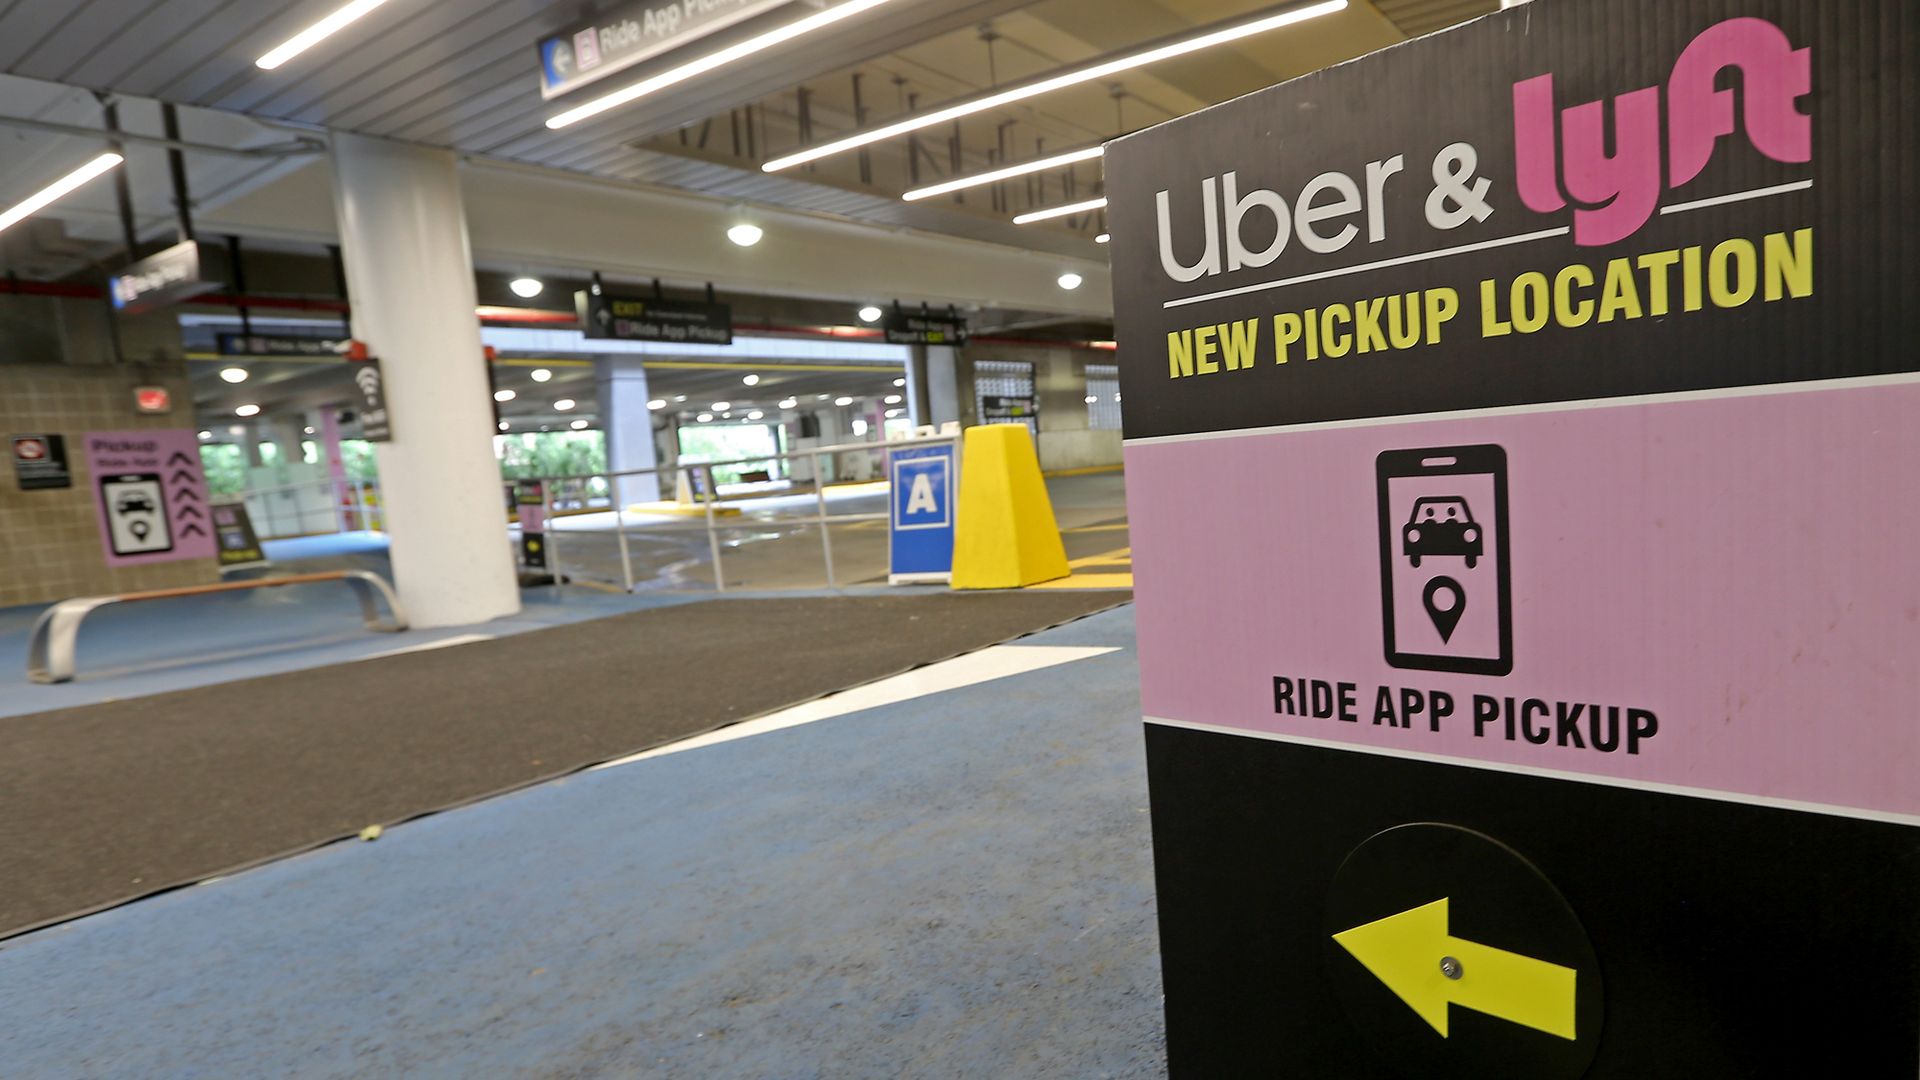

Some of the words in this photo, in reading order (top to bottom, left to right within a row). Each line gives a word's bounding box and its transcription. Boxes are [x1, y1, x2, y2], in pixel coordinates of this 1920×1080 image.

[600, 19, 641, 53] Ride
[642, 3, 681, 36] App
[1156, 154, 1404, 283] Uber
[1424, 142, 1495, 230] &
[1513, 17, 1812, 247] lyft
[612, 301, 644, 316] EXIT
[1167, 318, 1259, 379] NEW
[1273, 287, 1459, 365] PICKUP
[1480, 227, 1813, 338] LOCATION
[906, 473, 938, 514] A
[1273, 676, 1358, 723] RIDE
[1373, 685, 1455, 732] APP
[1473, 694, 1659, 755] PICKUP
